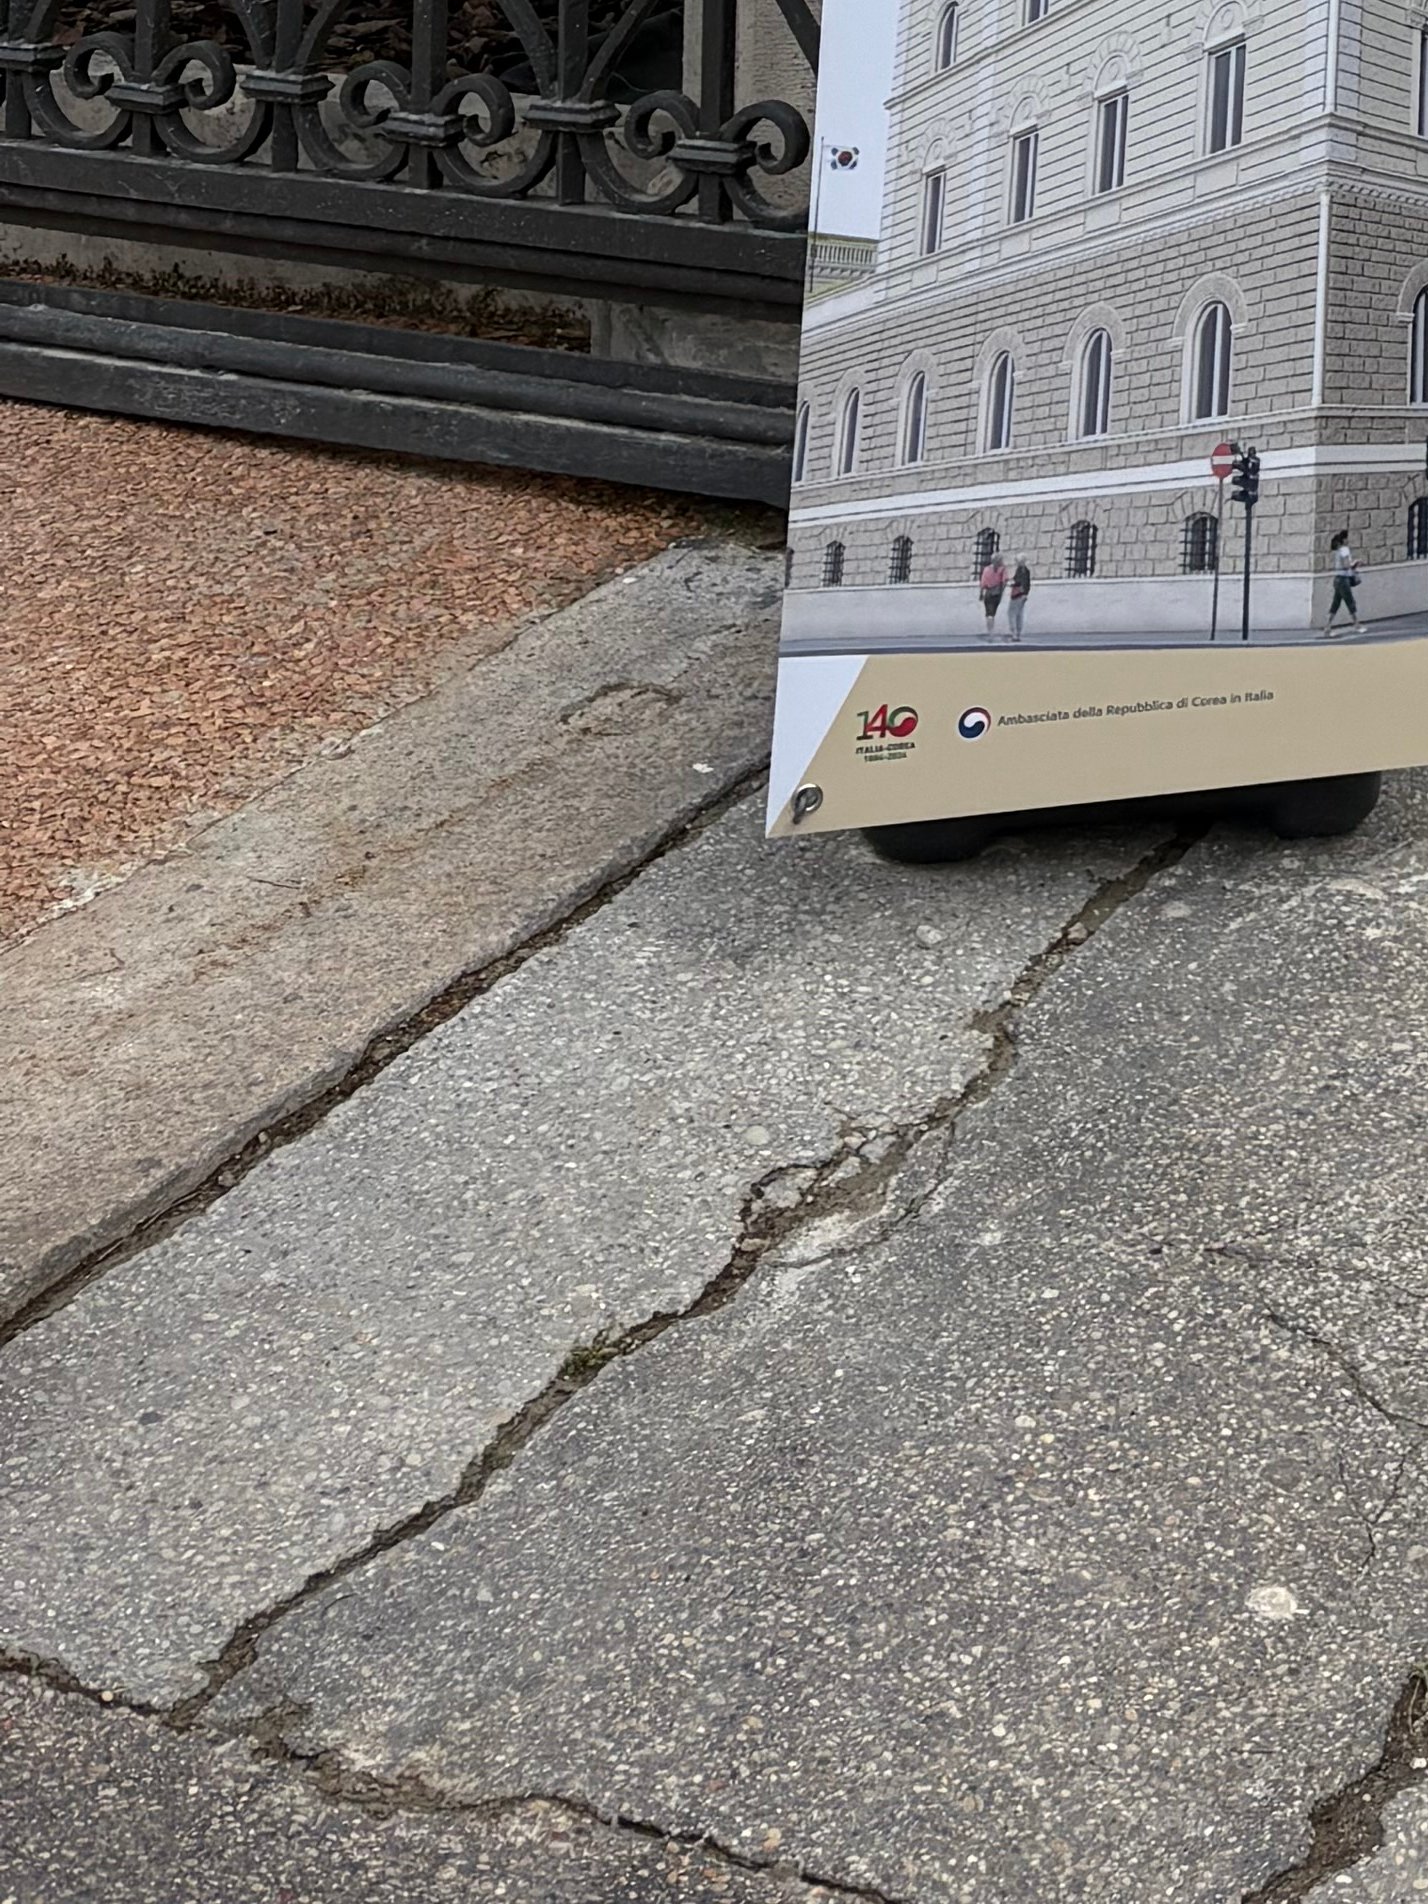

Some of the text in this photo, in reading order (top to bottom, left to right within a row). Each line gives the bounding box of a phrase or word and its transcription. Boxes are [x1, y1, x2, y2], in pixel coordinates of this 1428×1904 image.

[856, 703, 919, 741] 140
[997, 690, 1274, 726] Ambasciata della Repubblica di Corea in Italia
